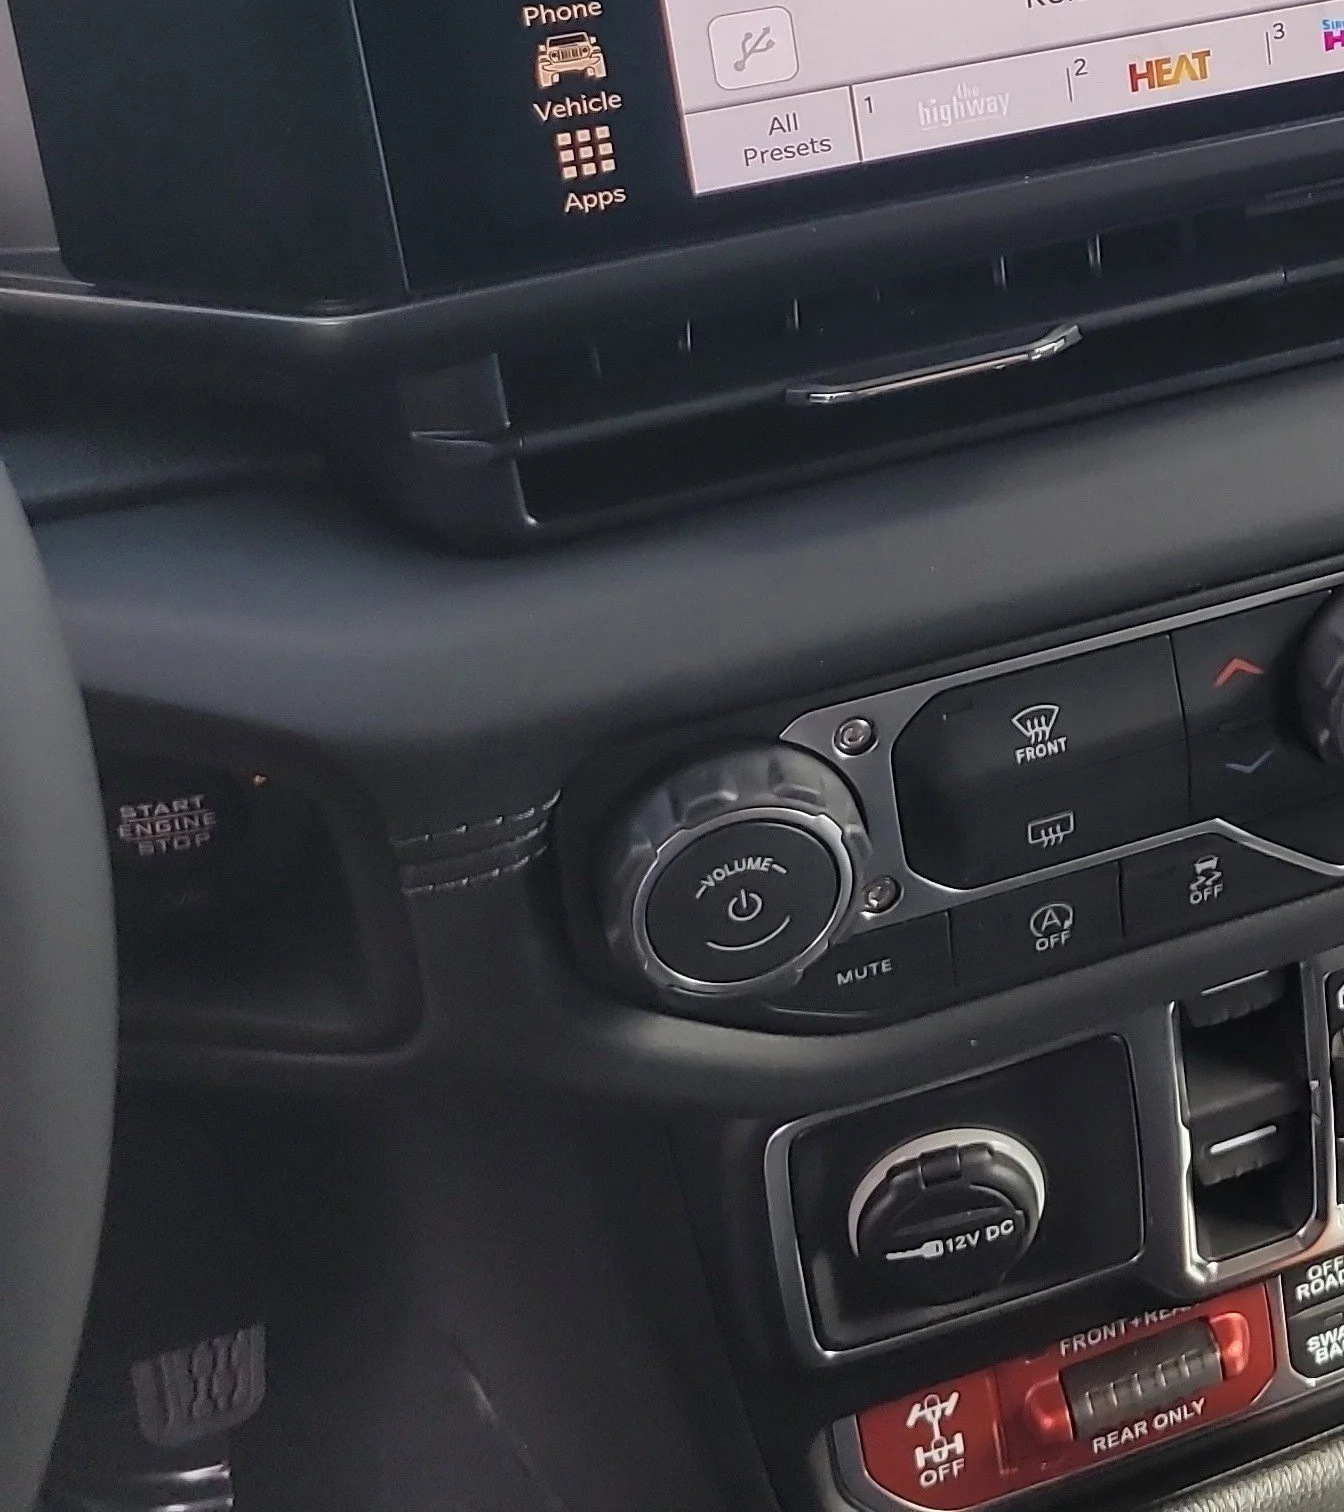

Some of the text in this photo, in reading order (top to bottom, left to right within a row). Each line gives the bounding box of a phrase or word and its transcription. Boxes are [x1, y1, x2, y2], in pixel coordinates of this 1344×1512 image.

[1272, 22, 1286, 41] 3
[1074, 57, 1089, 77] 2
[1127, 49, 1212, 93] HEAT
[533, 90, 623, 123] Vehicle
[864, 95, 875, 115] 1
[917, 92, 1010, 128] highway
[767, 113, 800, 137] All
[743, 136, 833, 168] Presets
[563, 186, 628, 215] Apps
[1015, 735, 1068, 763] FRONT
[118, 811, 217, 840] ENGINE
[700, 856, 774, 888] VOLUME
[1188, 883, 1225, 905] OFF
[1035, 930, 1072, 952] OFF
[836, 958, 893, 987] MUTE
[944, 1218, 1016, 1254] 12V DC
[1093, 1397, 1206, 1455] REAR ONLY
[919, 1458, 966, 1488] OFF
